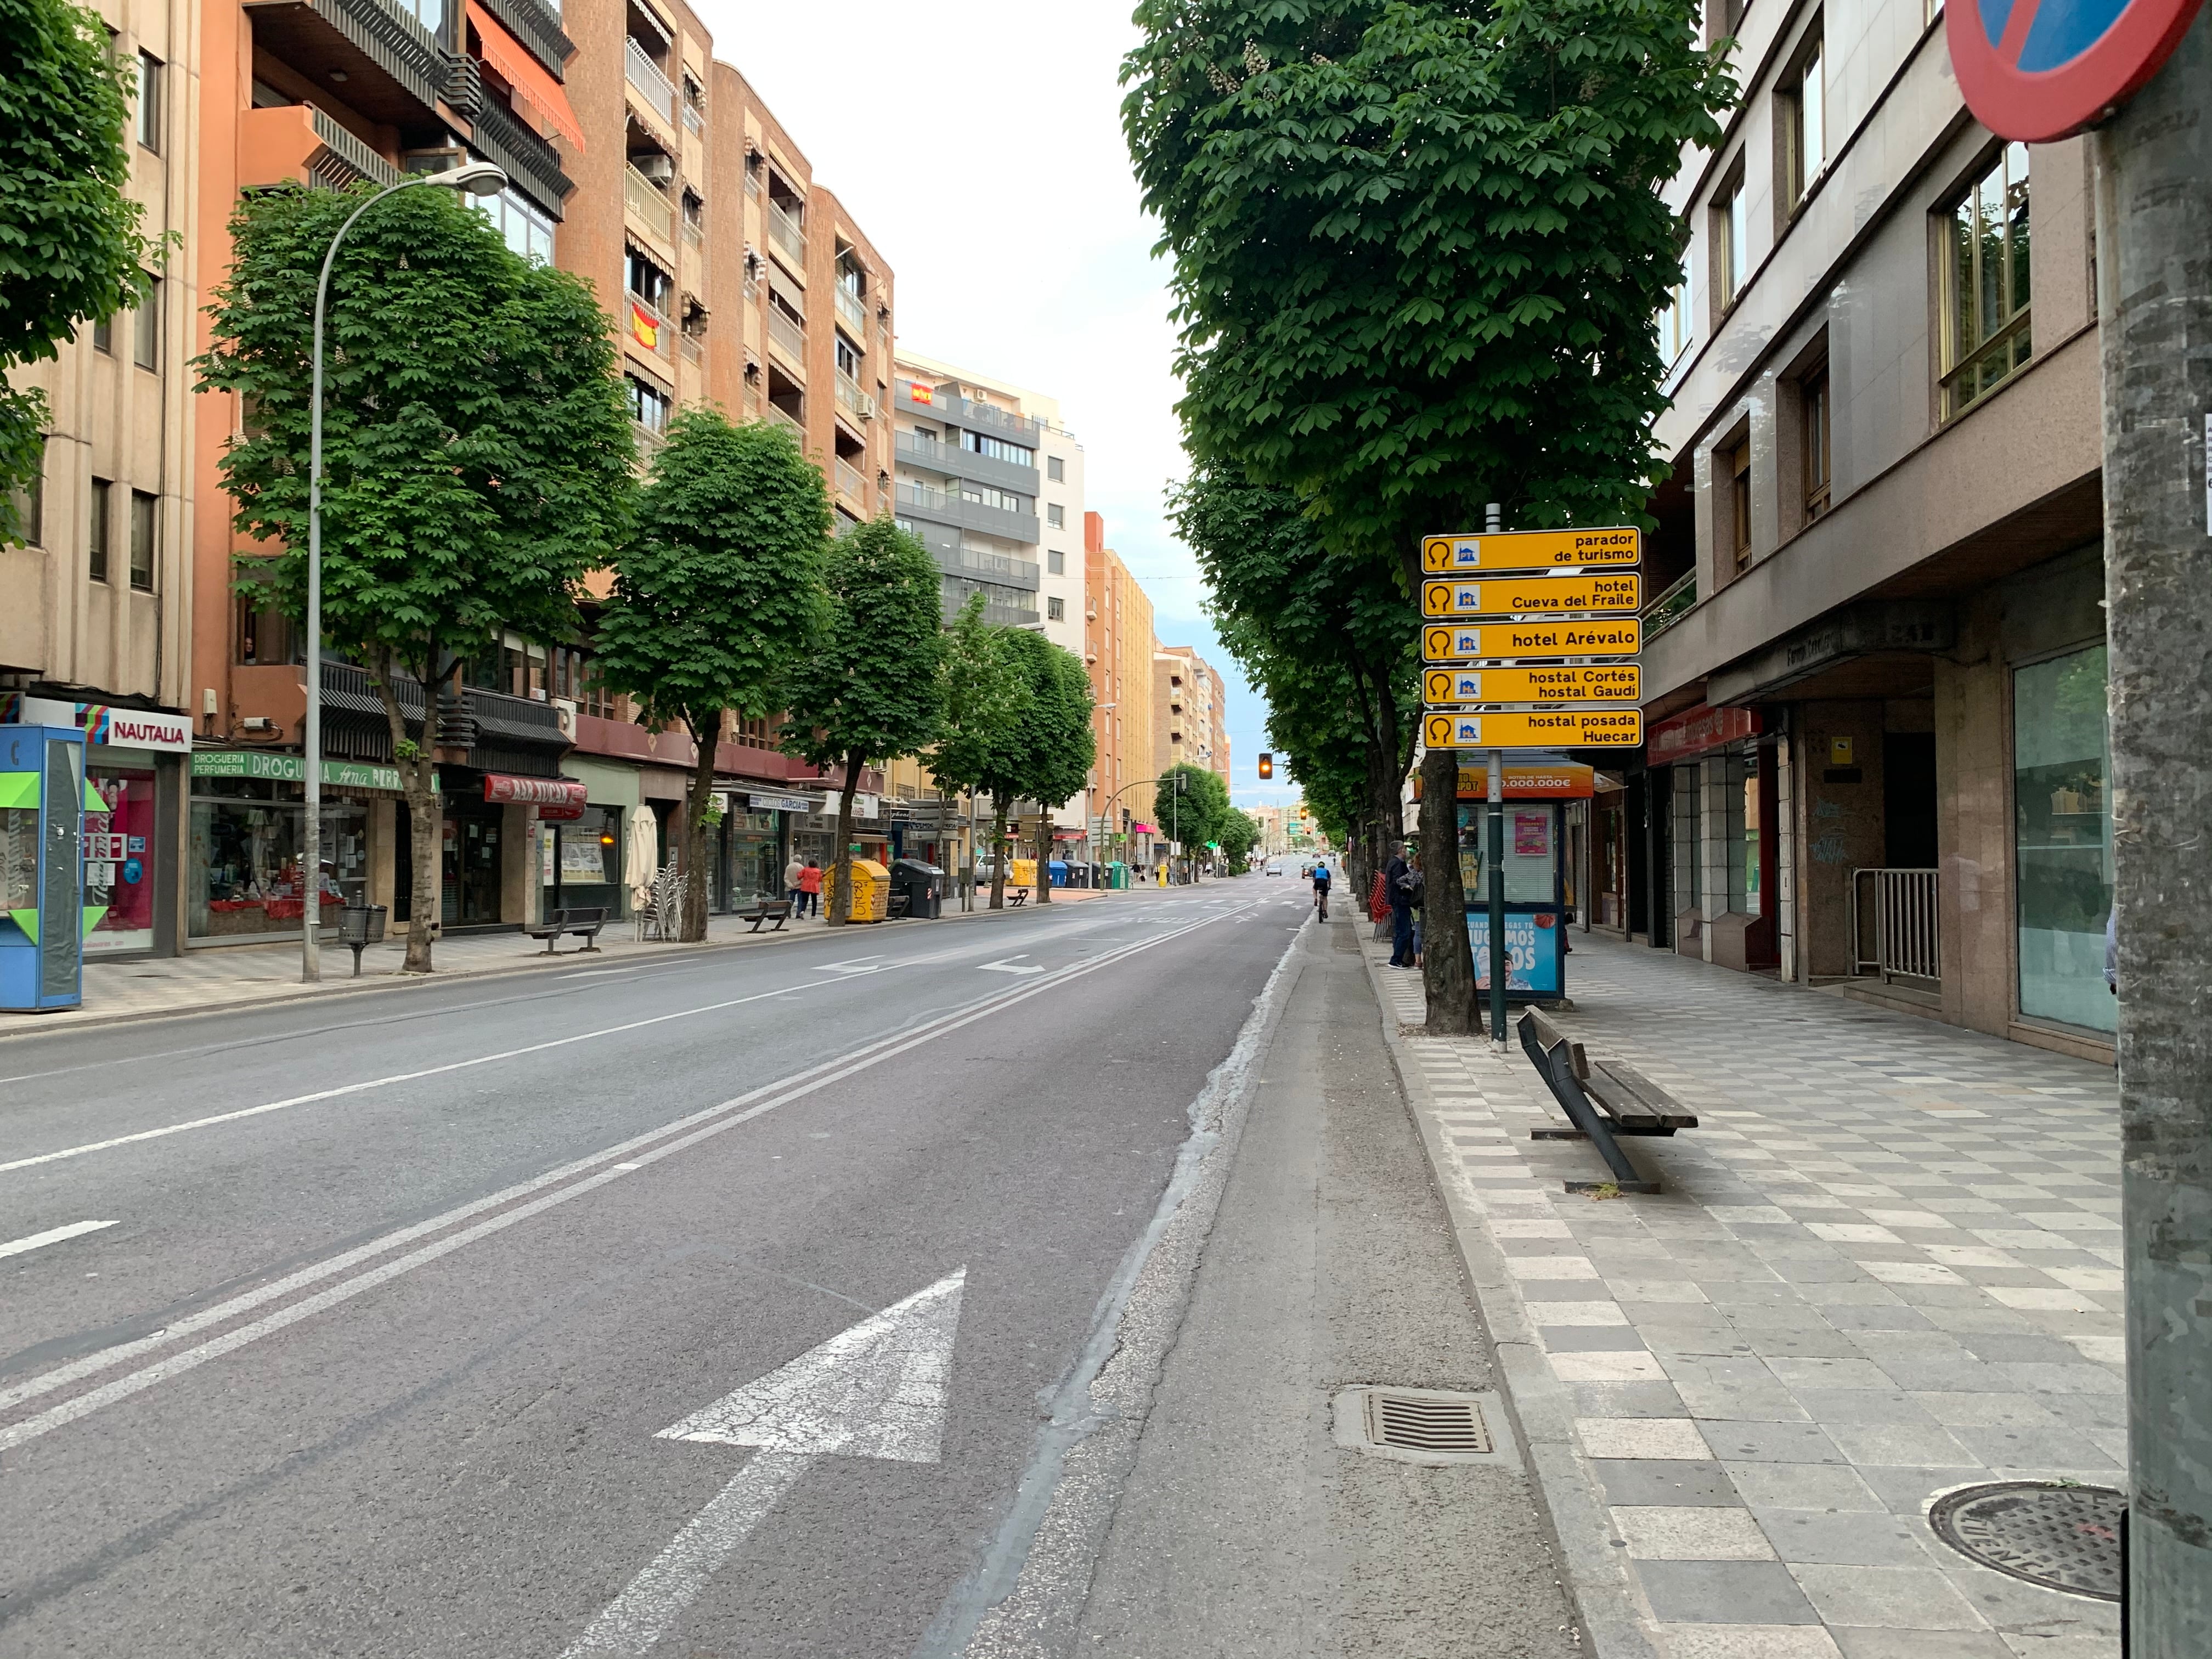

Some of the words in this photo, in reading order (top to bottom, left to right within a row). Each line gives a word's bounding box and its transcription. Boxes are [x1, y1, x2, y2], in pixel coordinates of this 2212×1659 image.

[1576, 534, 1634, 549] parador
[1554, 551, 1572, 561] de
[1578, 548, 1634, 561] turismo
[1594, 580, 1634, 592] hotel
[1512, 597, 1559, 608] Cueva
[1564, 595, 1587, 607] del
[1592, 593, 1634, 606] Fraile
[1513, 633, 1558, 647] hotel
[1565, 630, 1635, 645] Arévalo
[1529, 671, 1576, 684] hostal
[1583, 669, 1635, 682] Cortés
[1538, 685, 1585, 697] hostal
[1593, 684, 1635, 696] Gaudí
[1528, 715, 1576, 728] hostal
[1581, 715, 1635, 729] posada
[114, 721, 185, 744] NAUTALIA
[1583, 730, 1636, 743] Huecar
[194, 754, 245, 764] DROGUERIA
[194, 765, 244, 775] PERFUMERIA
[253, 755, 330, 783] DROGUIA
[334, 765, 368, 786] Ana
[512, 779, 533, 802] BAR
[763, 797, 780, 808] CICLOS
[781, 799, 802, 810] GARCIA
[1469, 930, 1535, 946] JUGMOS
